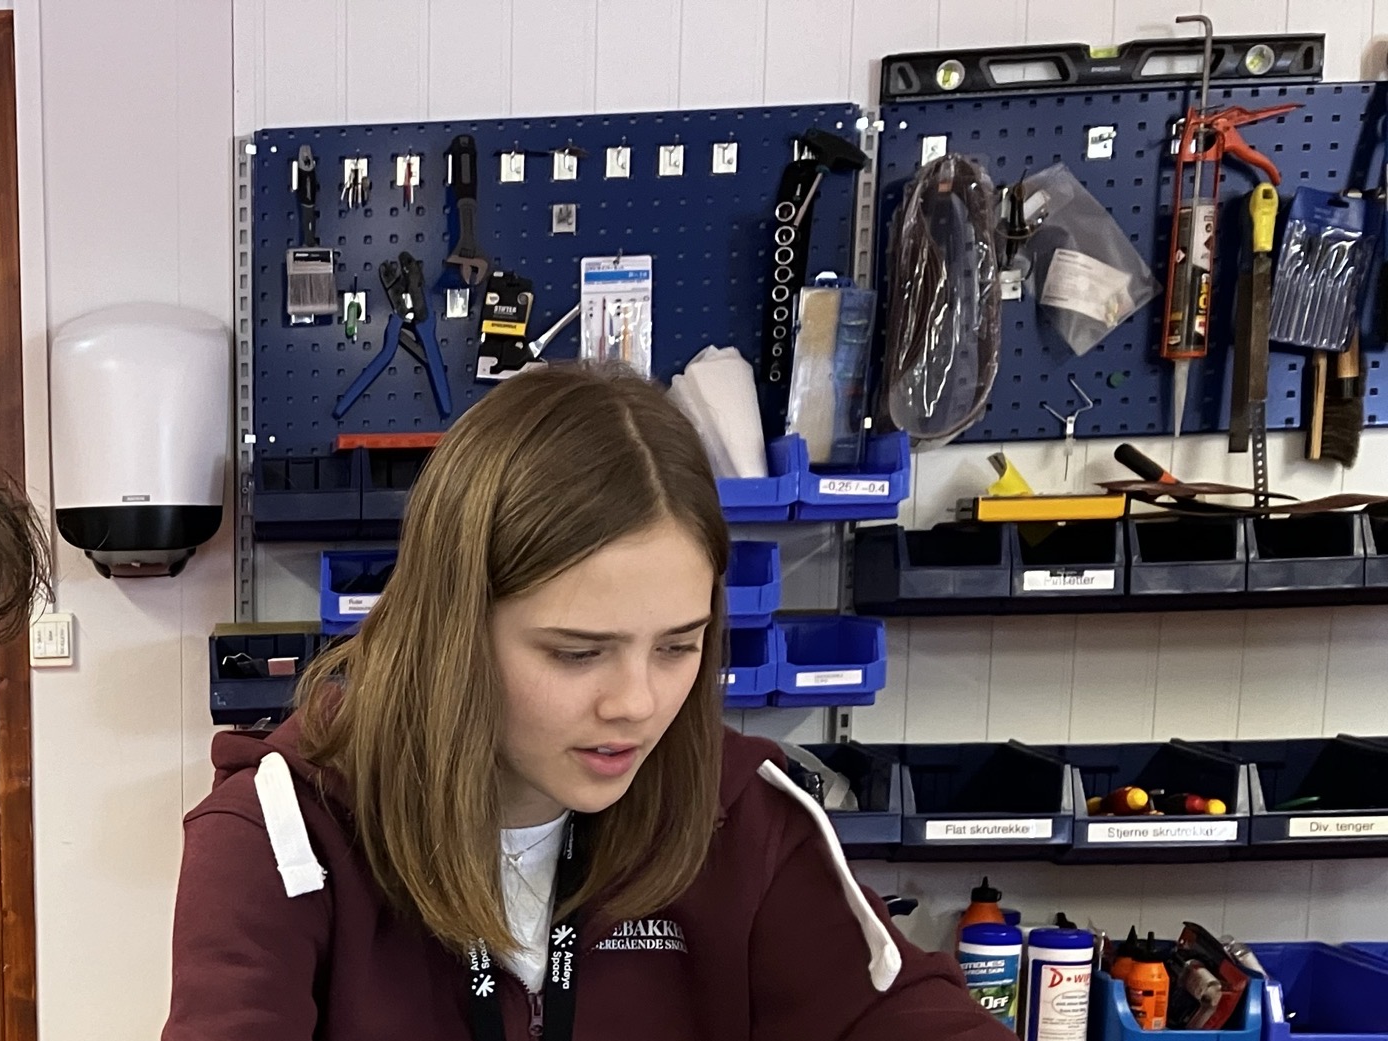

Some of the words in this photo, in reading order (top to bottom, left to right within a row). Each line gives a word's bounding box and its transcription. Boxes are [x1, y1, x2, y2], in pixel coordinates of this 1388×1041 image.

[945, 824, 967, 835] Flat
[969, 824, 1031, 835] skrutrekke
[1107, 827, 1149, 838] Stjerne
[1335, 822, 1376, 833] tenger
[597, 937, 664, 950] EREGÅENDE
[478, 937, 491, 970] Space
[551, 951, 562, 982] Space
[560, 951, 574, 990] Andøya
